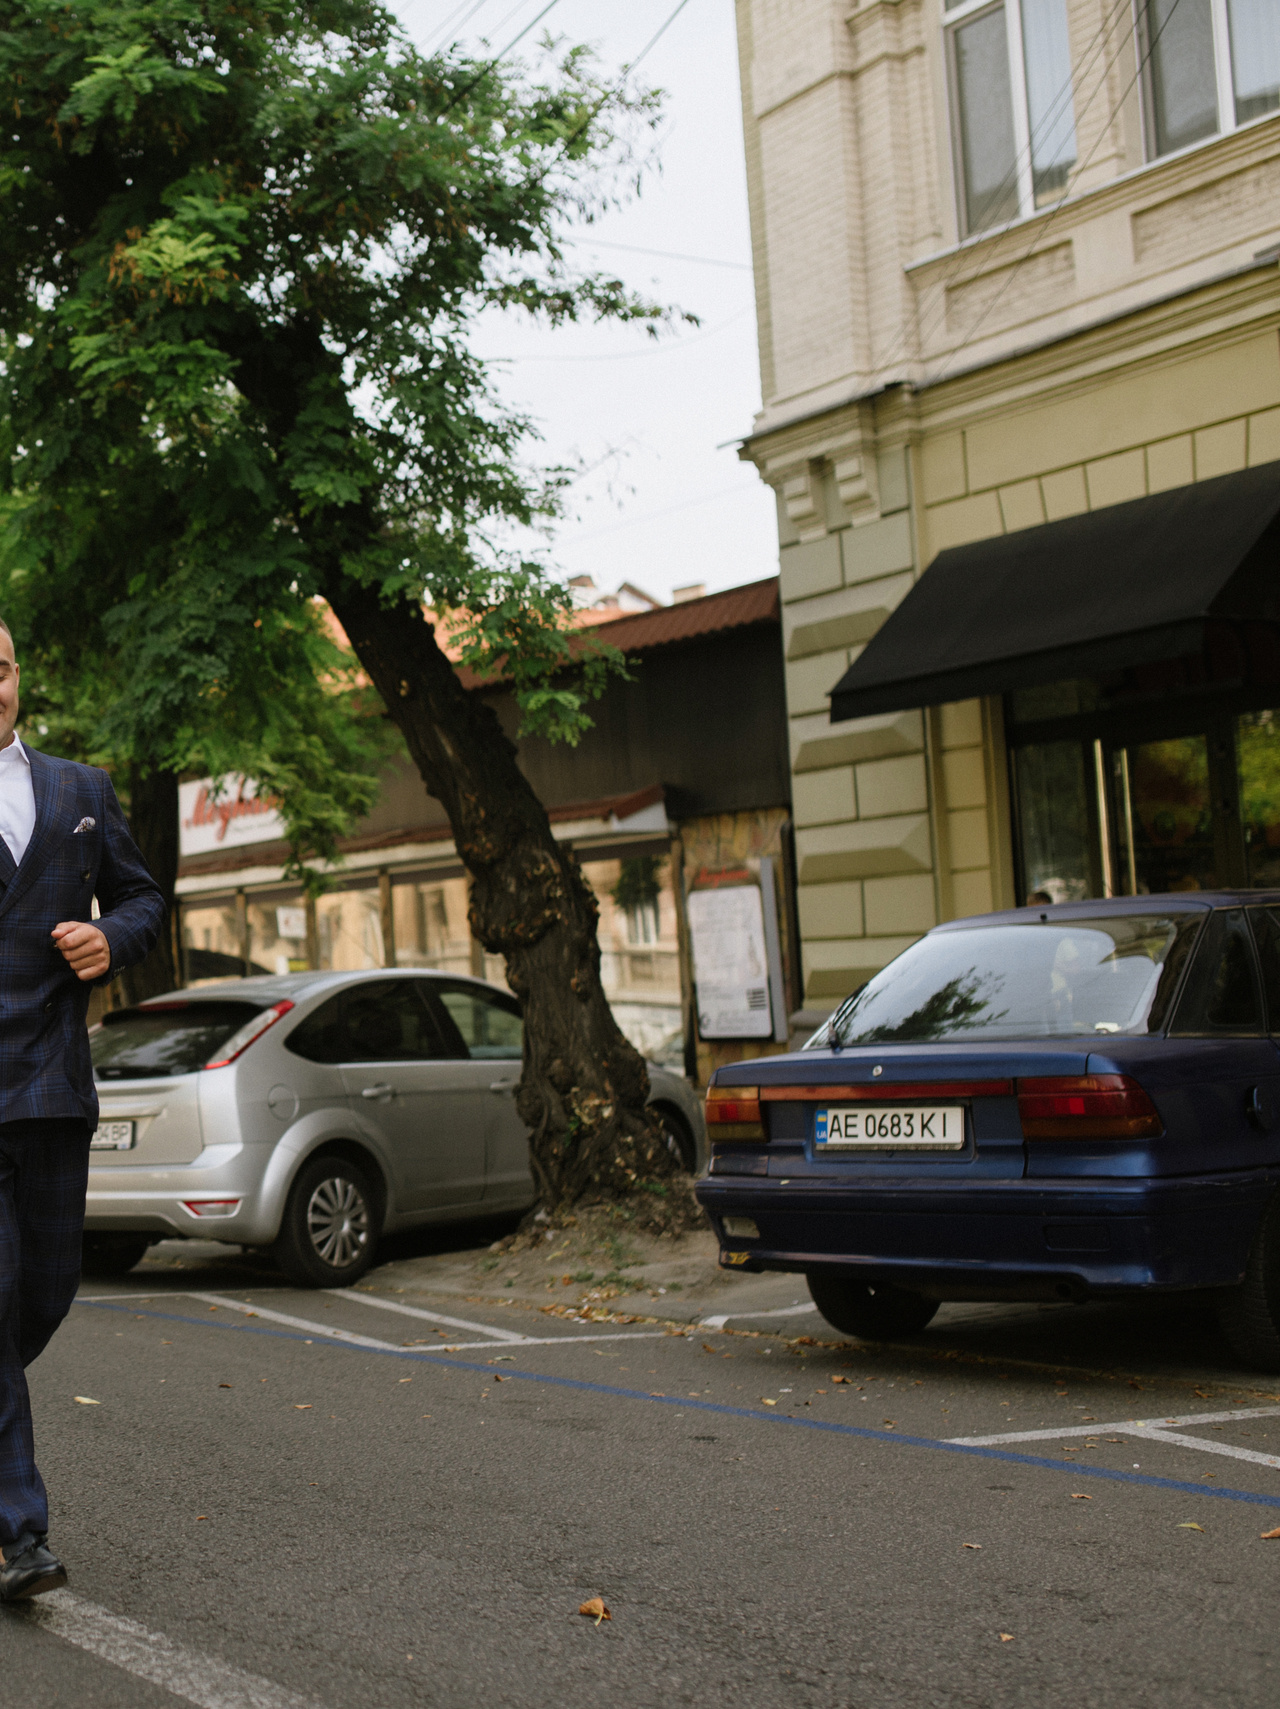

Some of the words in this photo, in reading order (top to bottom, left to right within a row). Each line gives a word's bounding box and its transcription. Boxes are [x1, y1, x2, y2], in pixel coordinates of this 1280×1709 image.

[829, 1114, 858, 1138] AE
[865, 1113, 914, 1138] 0683
[921, 1112, 946, 1138] KI
